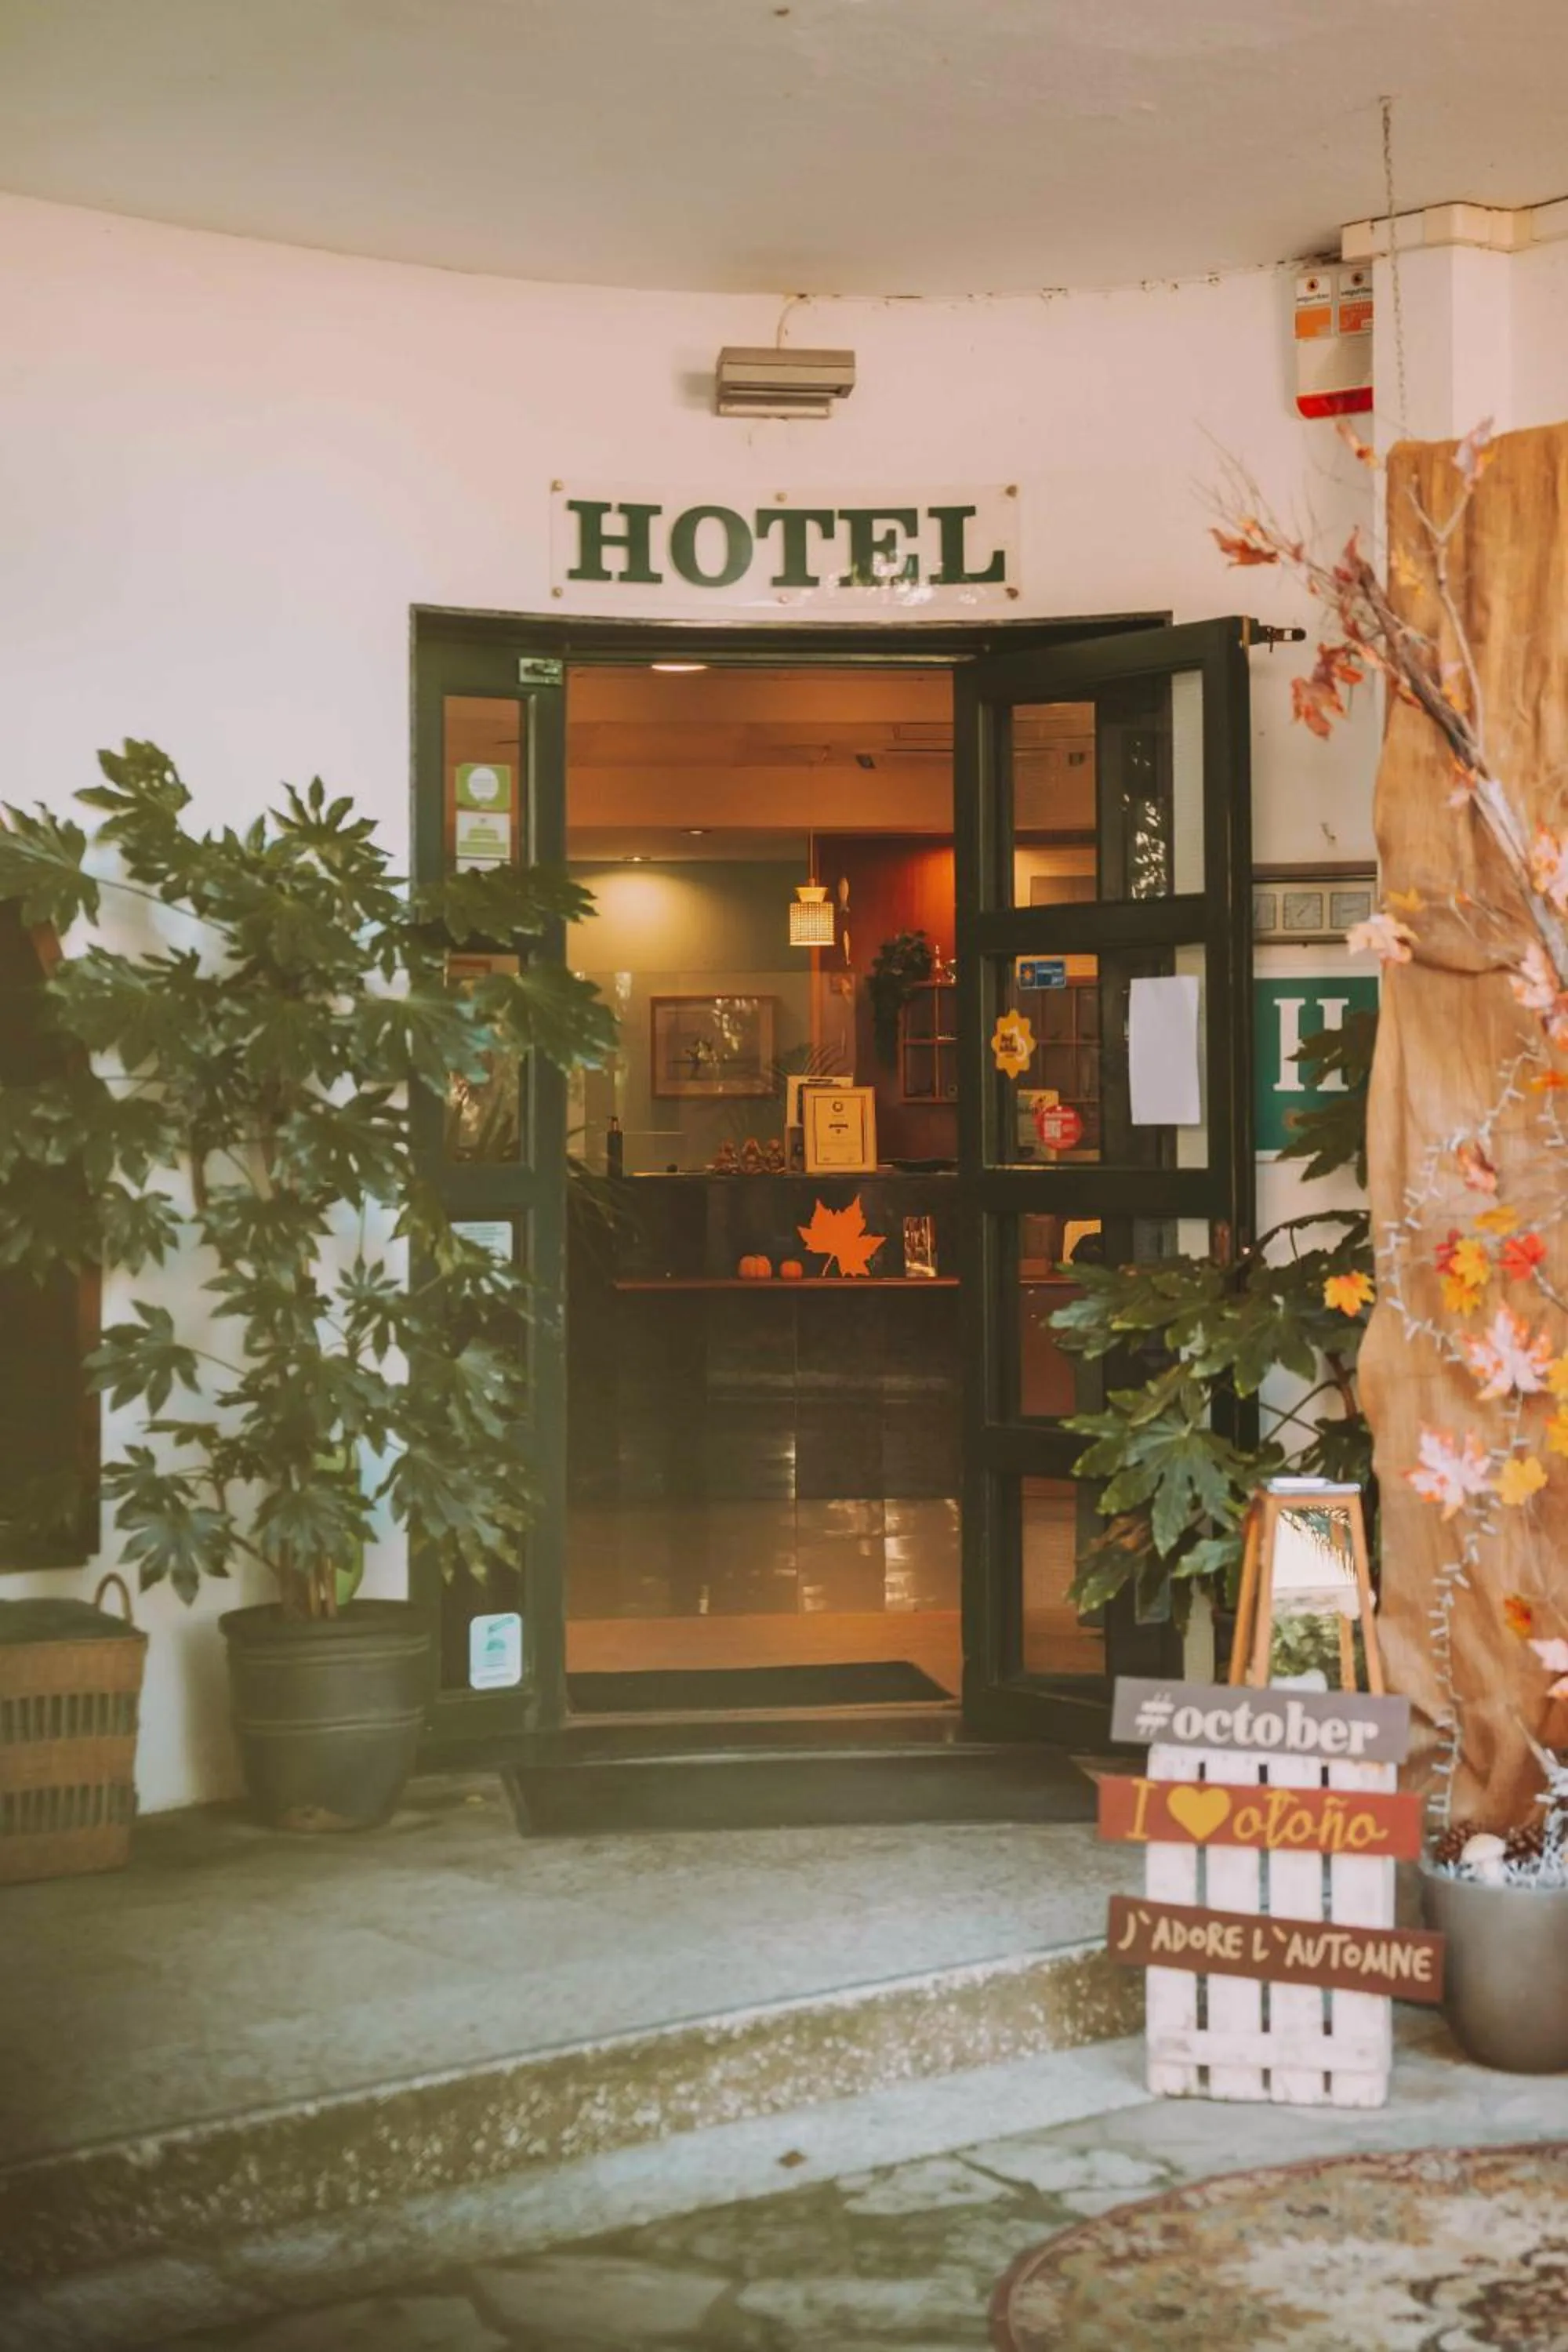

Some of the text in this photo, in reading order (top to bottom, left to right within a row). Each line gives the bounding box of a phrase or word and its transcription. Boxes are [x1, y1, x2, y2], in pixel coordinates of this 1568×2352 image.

[567, 499, 1006, 588] HOTEL
[1273, 997, 1349, 1092] H
[1134, 1692, 1379, 1755] #october
[1125, 1778, 1388, 1849] I otoño
